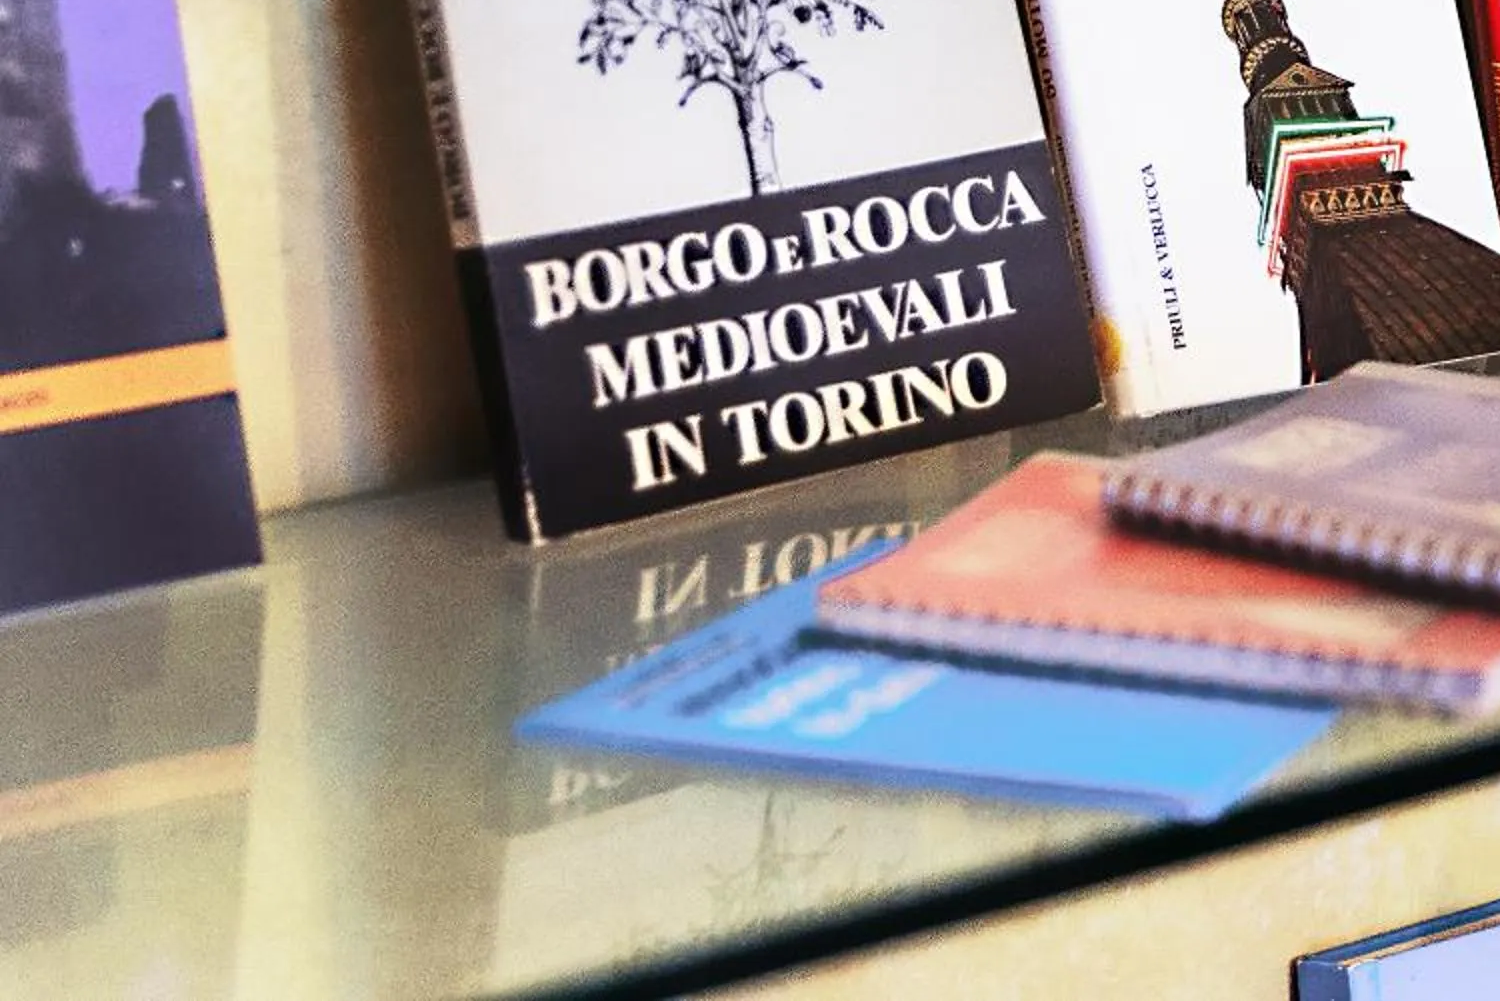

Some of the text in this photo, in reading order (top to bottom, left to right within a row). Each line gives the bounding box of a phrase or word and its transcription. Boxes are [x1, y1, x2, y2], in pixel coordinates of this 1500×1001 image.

[522, 220, 768, 330] BORGO
[772, 234, 804, 276] E
[800, 170, 1046, 261] ROCCA
[1140, 162, 1187, 350] PRIULI & VERLUCCA
[583, 259, 1018, 411] MEDIOEVALI
[623, 350, 1008, 494] IN TORINO
